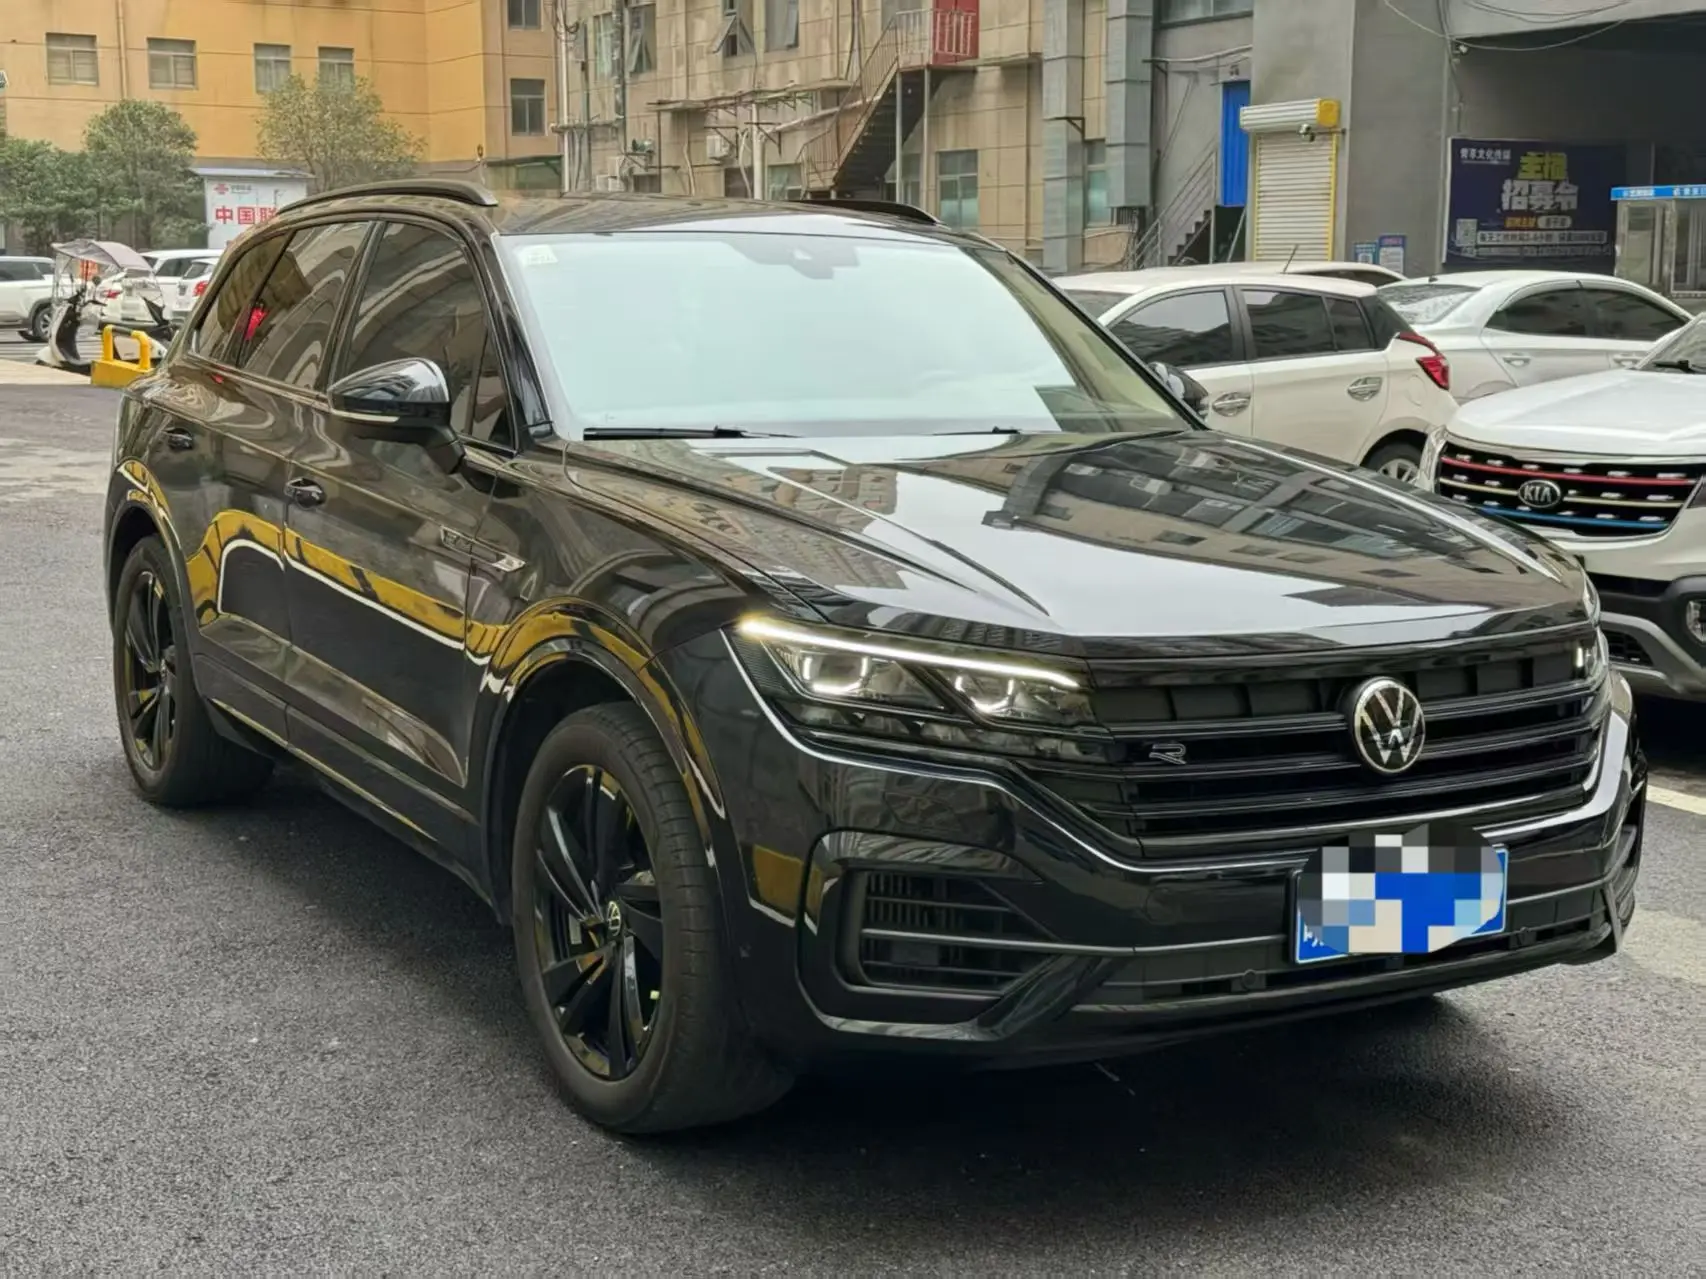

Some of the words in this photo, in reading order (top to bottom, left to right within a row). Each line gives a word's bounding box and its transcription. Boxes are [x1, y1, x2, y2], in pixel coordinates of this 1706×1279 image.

[1518, 151, 1568, 181] 主播
[1501, 178, 1579, 212] 招募令
[1523, 484, 1552, 503] KIA
[1149, 742, 1187, 765] R
